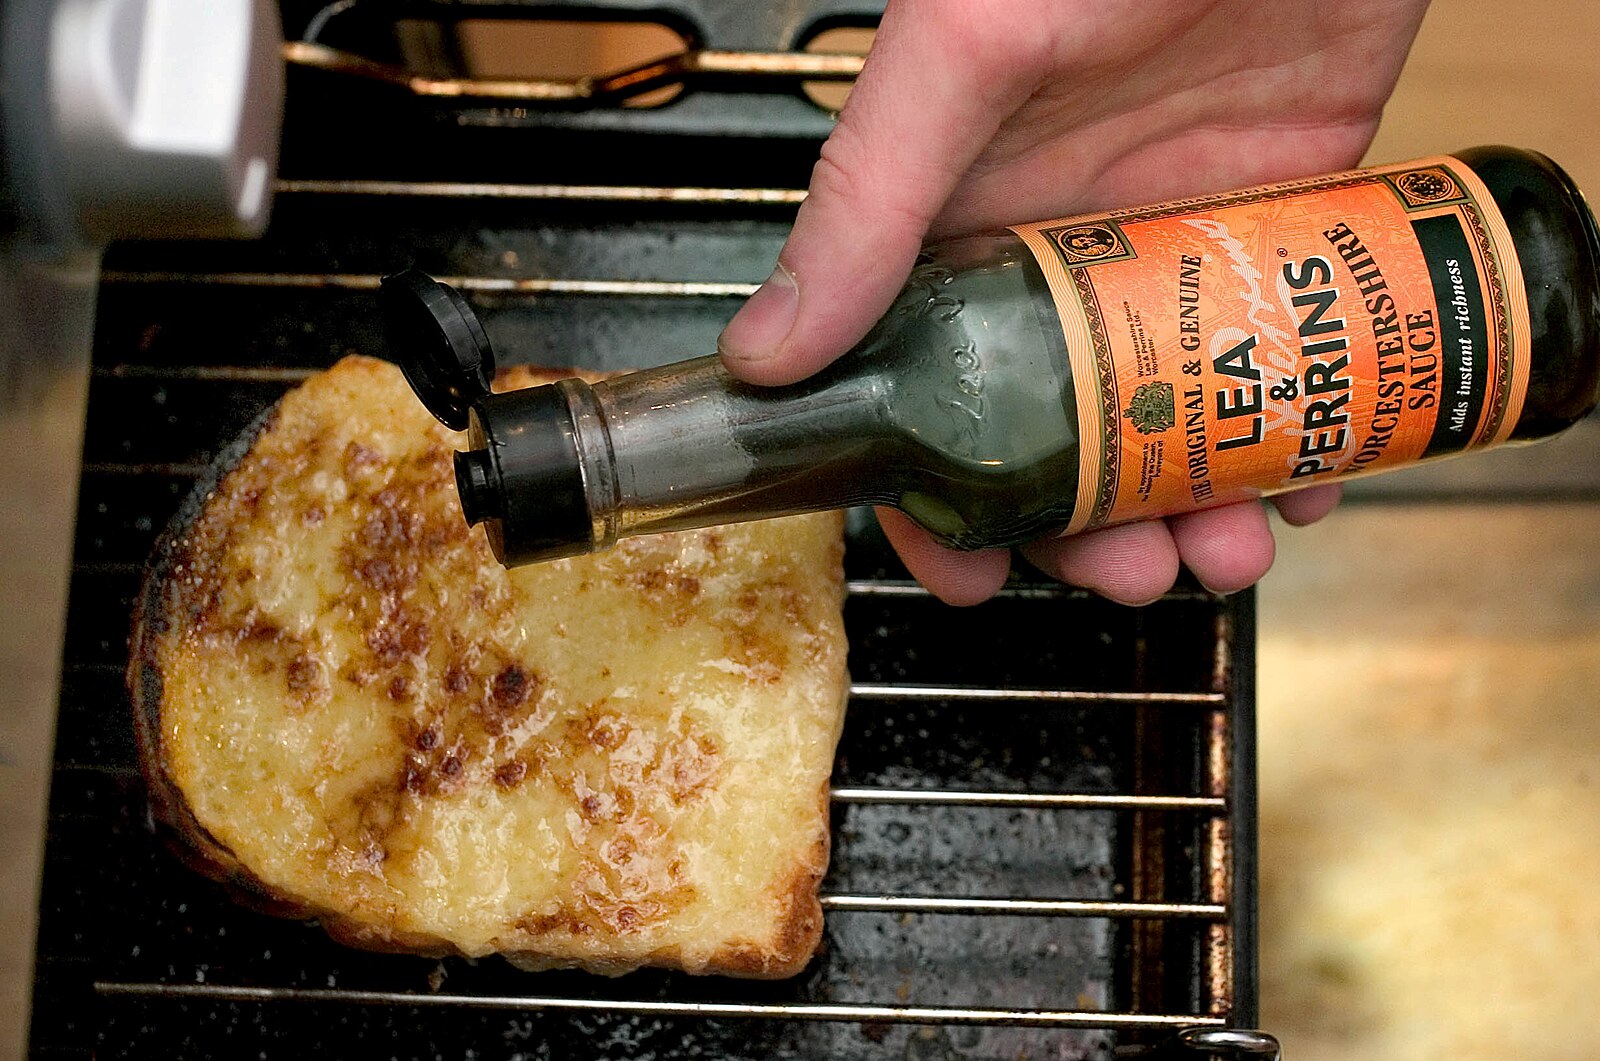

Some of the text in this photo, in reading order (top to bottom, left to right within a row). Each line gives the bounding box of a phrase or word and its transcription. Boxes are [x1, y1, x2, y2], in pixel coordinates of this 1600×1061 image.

[1123, 300, 1144, 378] Worcestershire Sauce
[1138, 328, 1149, 354] Perrins
[1179, 254, 1202, 353] GENUINE
[1446, 258, 1473, 433] Adds instant richness
[1181, 358, 1202, 377] &
[1213, 333, 1264, 452] LEA
[1269, 374, 1299, 402] &
[1282, 255, 1351, 480] PERRINS
[1406, 309, 1437, 411] SAUCE
[1143, 442, 1149, 450] to
[1184, 383, 1209, 480] ORIGINAL
